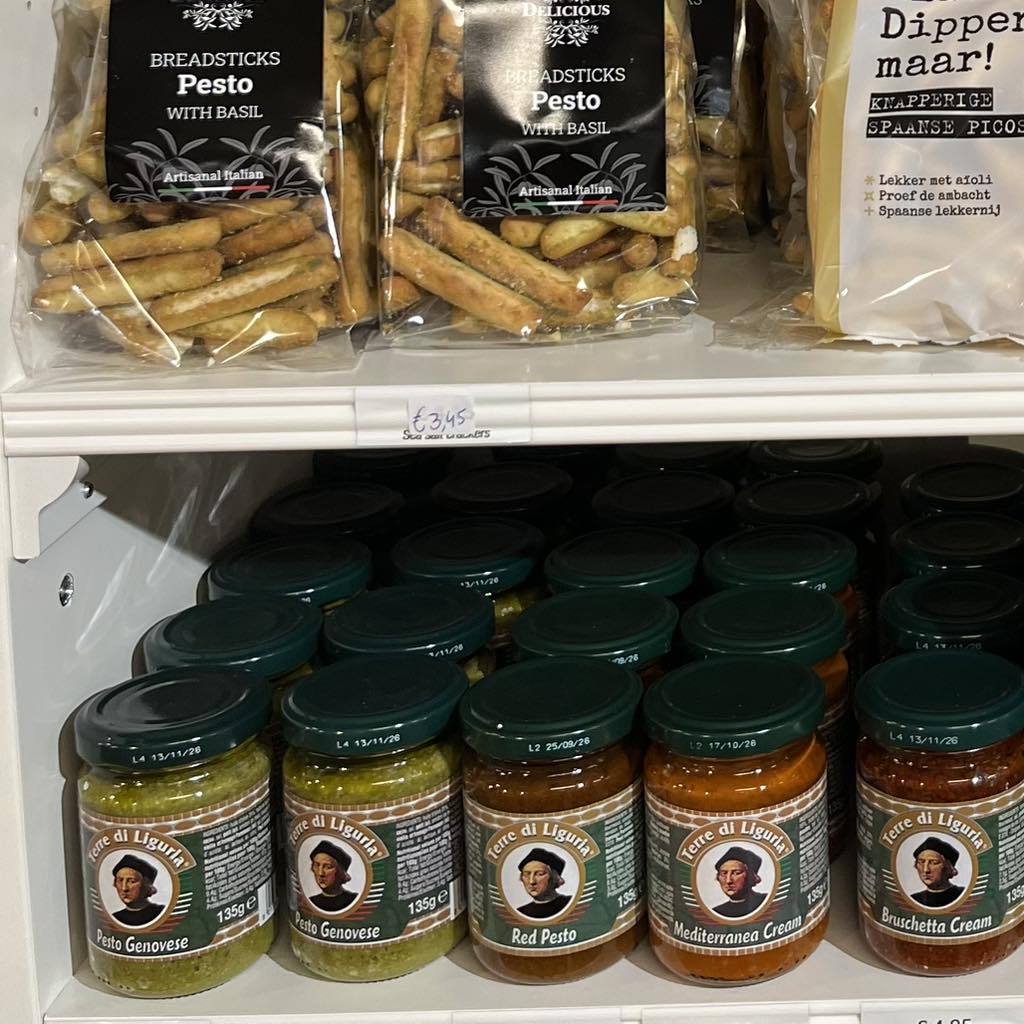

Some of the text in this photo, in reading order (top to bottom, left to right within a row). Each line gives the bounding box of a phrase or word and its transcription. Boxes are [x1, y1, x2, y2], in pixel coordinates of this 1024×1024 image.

[522, 3, 611, 18] DELICIOUS
[150, 51, 281, 68] BREADSTICKS
[875, 42, 995, 79] maar!
[176, 73, 254, 95] Pesto
[505, 67, 627, 84] BREADSTICKS
[530, 90, 601, 112] Pesto
[869, 91, 993, 112] KNAPPERIGE
[166, 104, 263, 120] WITH BASIL
[521, 121, 611, 136] WITH BASIL
[867, 118, 955, 136] SPAANSE
[163, 168, 264, 183] Artisanal Italian
[879, 174, 927, 186] Lekker
[929, 175, 952, 186] met
[518, 183, 613, 197] Artisanal Italian
[879, 188, 991, 201] Proef de ambacht
[878, 205, 1001, 218] Spaanse lekkernij
[353, 732, 401, 748] 13/11/26
[908, 734, 960, 746] 13/11/26
[151, 745, 202, 762] 13/11/26
[311, 814, 379, 858] di Liguria
[681, 820, 787, 861] Terre di Liguria
[882, 811, 984, 851] Terre di Liguria
[113, 830, 130, 844] di
[133, 831, 186, 869] Liguria
[487, 823, 592, 859] Terre di Liguria
[216, 902, 245, 924] 135g
[407, 896, 436, 915] 135g
[295, 911, 381, 941] Pesto Genovese
[881, 905, 992, 934] Bruschetta Cream
[511, 926, 578, 946] Red Pesto
[673, 914, 803, 946] Mediterranea Cream
[97, 928, 190, 954] Pesto Genovese
